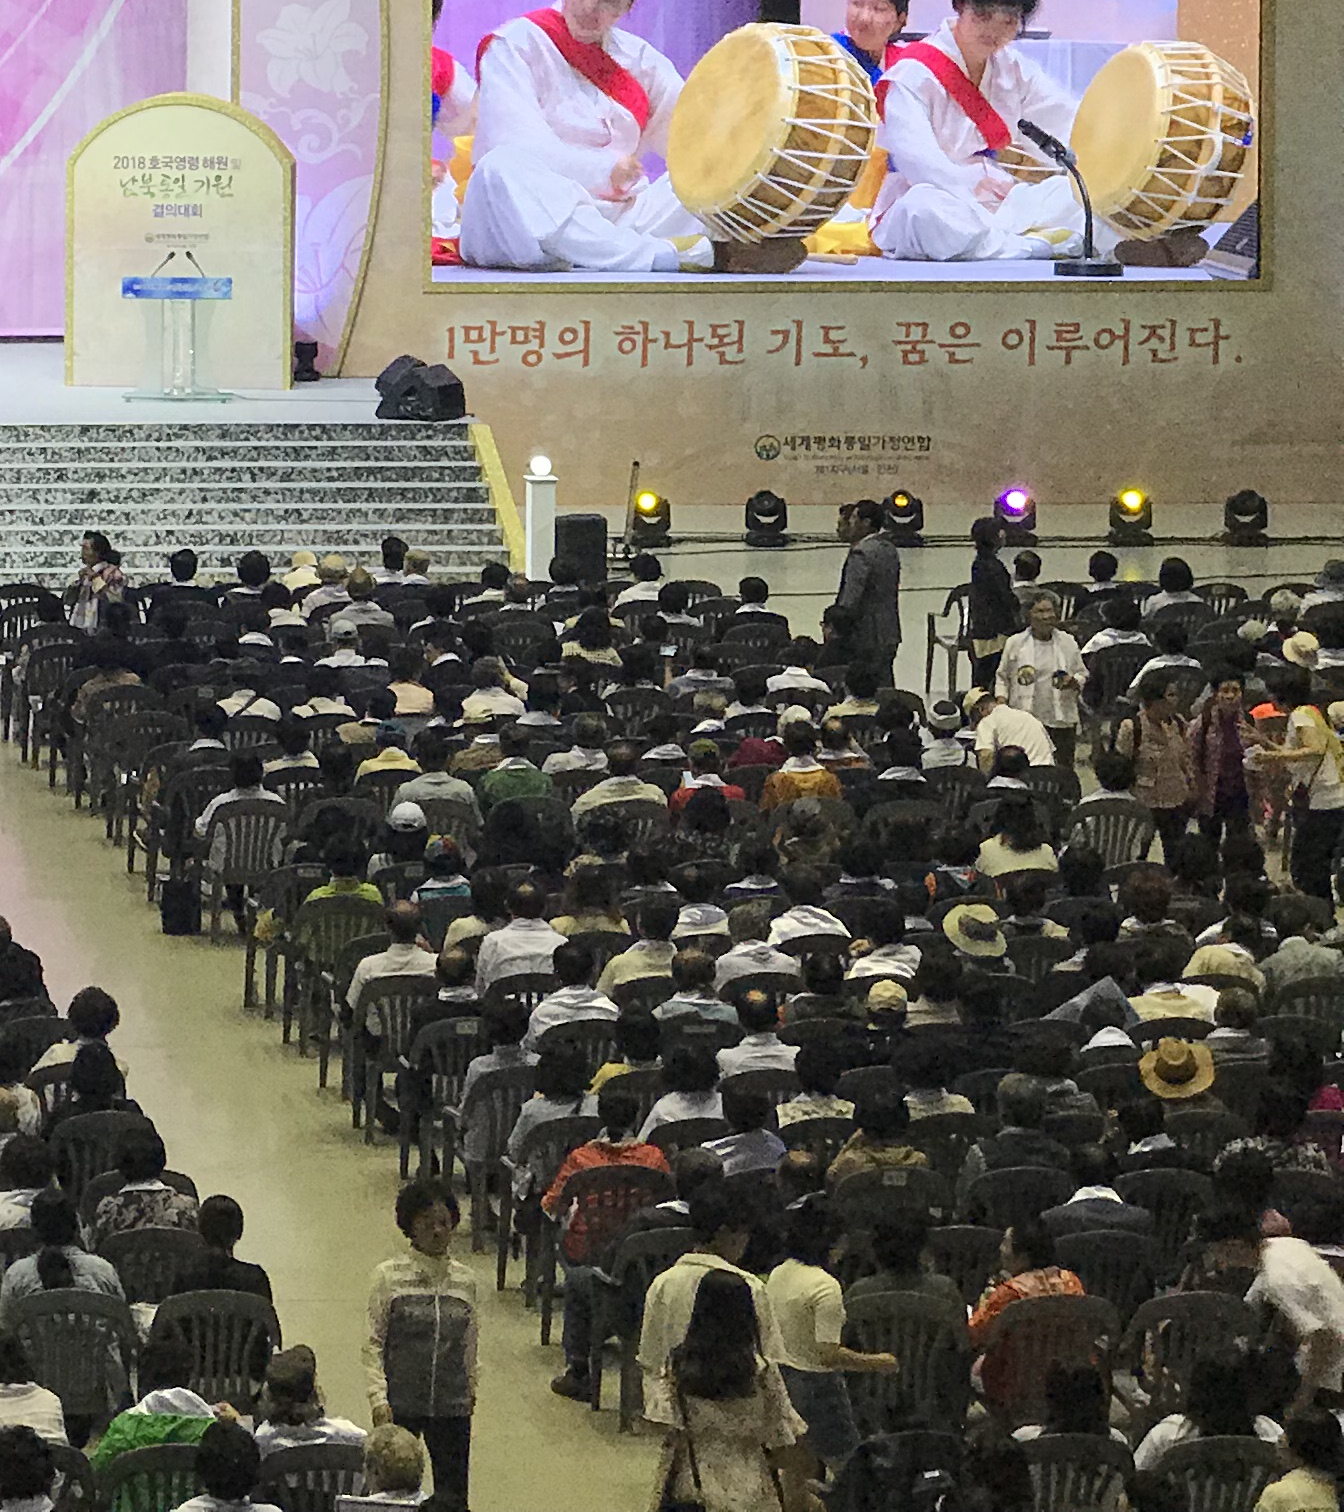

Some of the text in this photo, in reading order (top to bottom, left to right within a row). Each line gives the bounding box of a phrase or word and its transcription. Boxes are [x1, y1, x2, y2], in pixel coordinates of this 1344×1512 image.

[113, 155, 146, 170] 2018
[148, 155, 200, 171] 호국영령
[202, 155, 229, 171] 해원
[193, 174, 234, 198] 기원
[445, 317, 1243, 369] 1만명의 하나된 기도, 꿈은 이루어진다.
